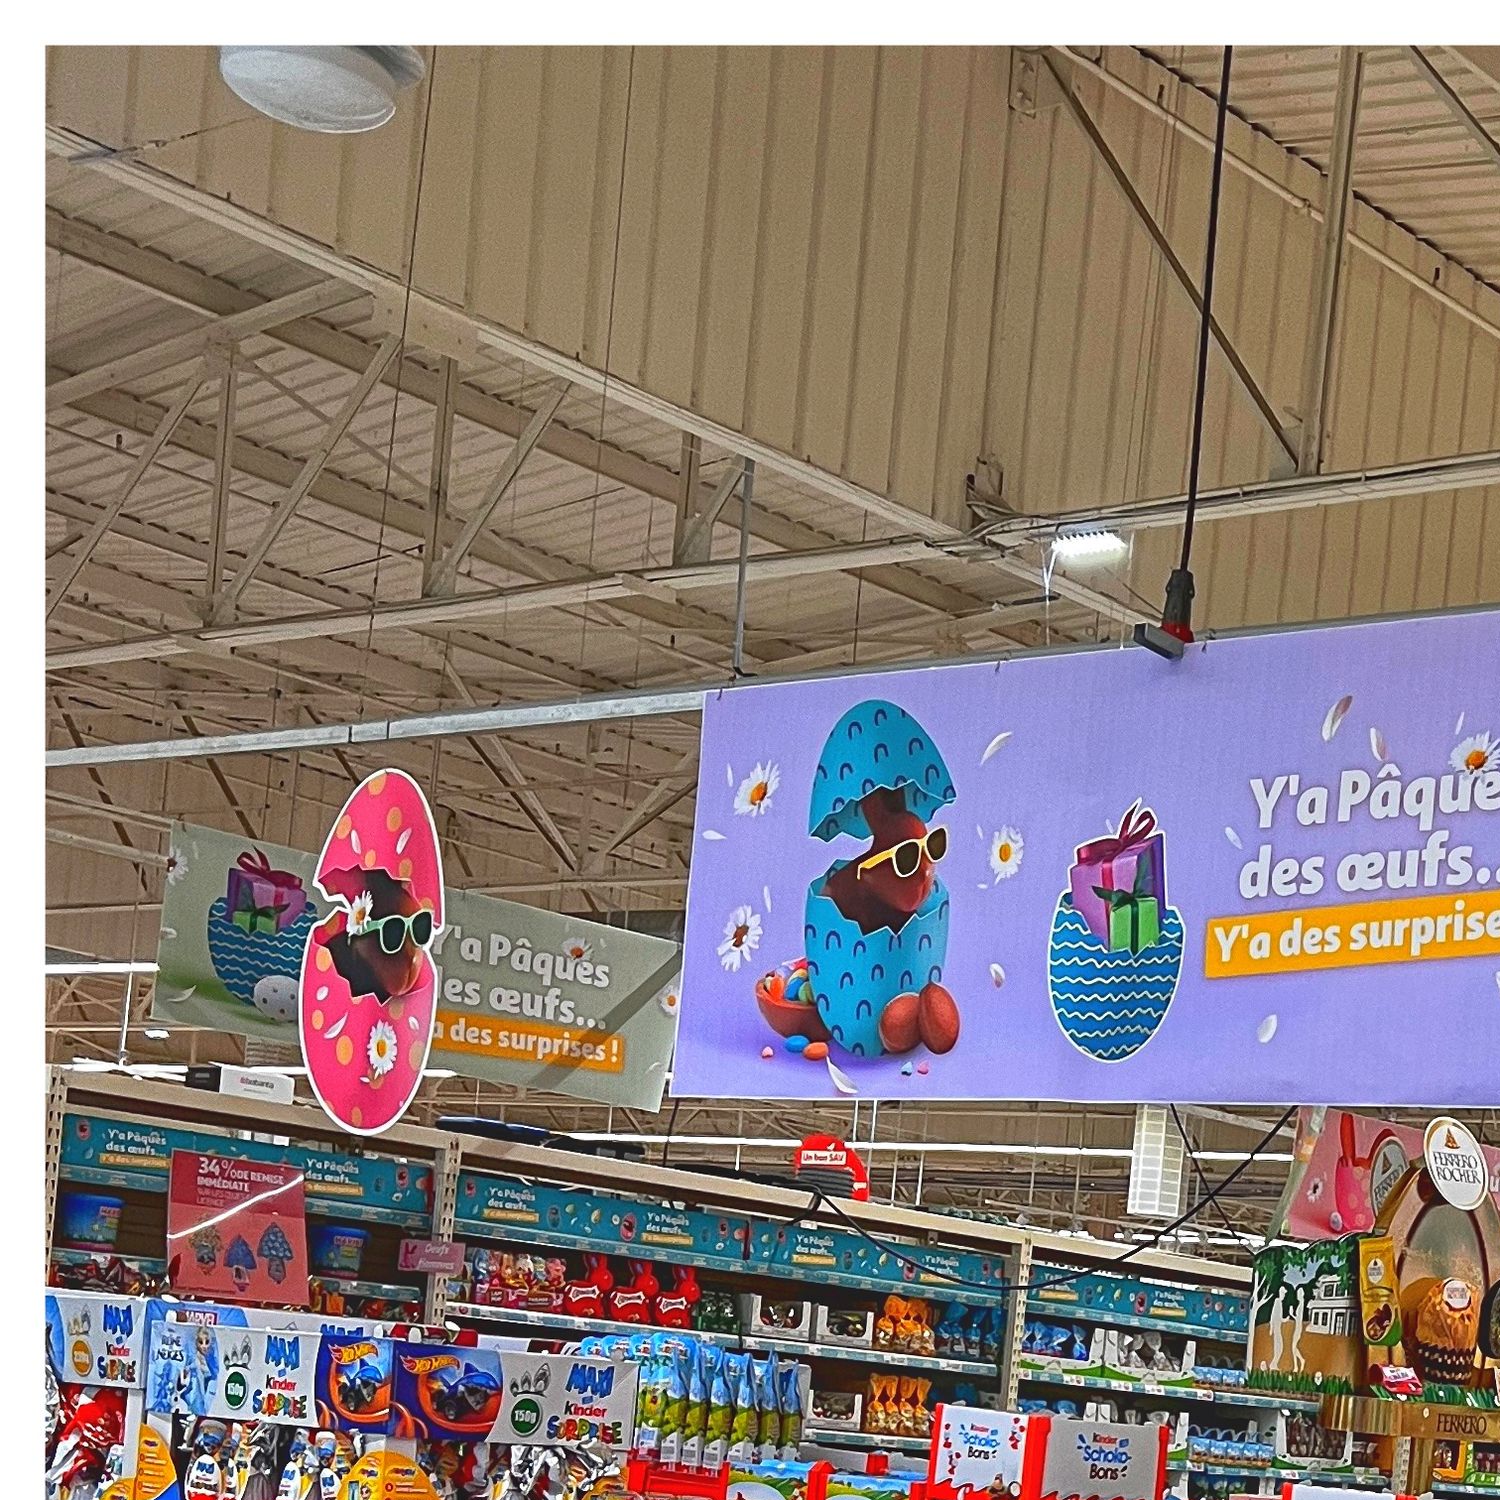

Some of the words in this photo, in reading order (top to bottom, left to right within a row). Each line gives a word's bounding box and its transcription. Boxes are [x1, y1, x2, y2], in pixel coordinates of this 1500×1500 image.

[1250, 774, 1328, 829] Y'a
[1239, 846, 1324, 899] des
[1214, 924, 1270, 963] Y'a
[1280, 918, 1340, 956] des
[489, 933, 610, 988] Pâques
[450, 1018, 491, 1045] des
[499, 1031, 606, 1062] surprises
[1434, 1152, 1478, 1169] FERRERO
[1437, 1166, 1481, 1185] ROCHER
[265, 1374, 297, 1392] Kinder
[564, 1401, 607, 1419] Kinder
[1437, 1414, 1487, 1434] FERRERO
[967, 1446, 990, 1459] Bons
[1089, 1463, 1119, 1480] Bons
